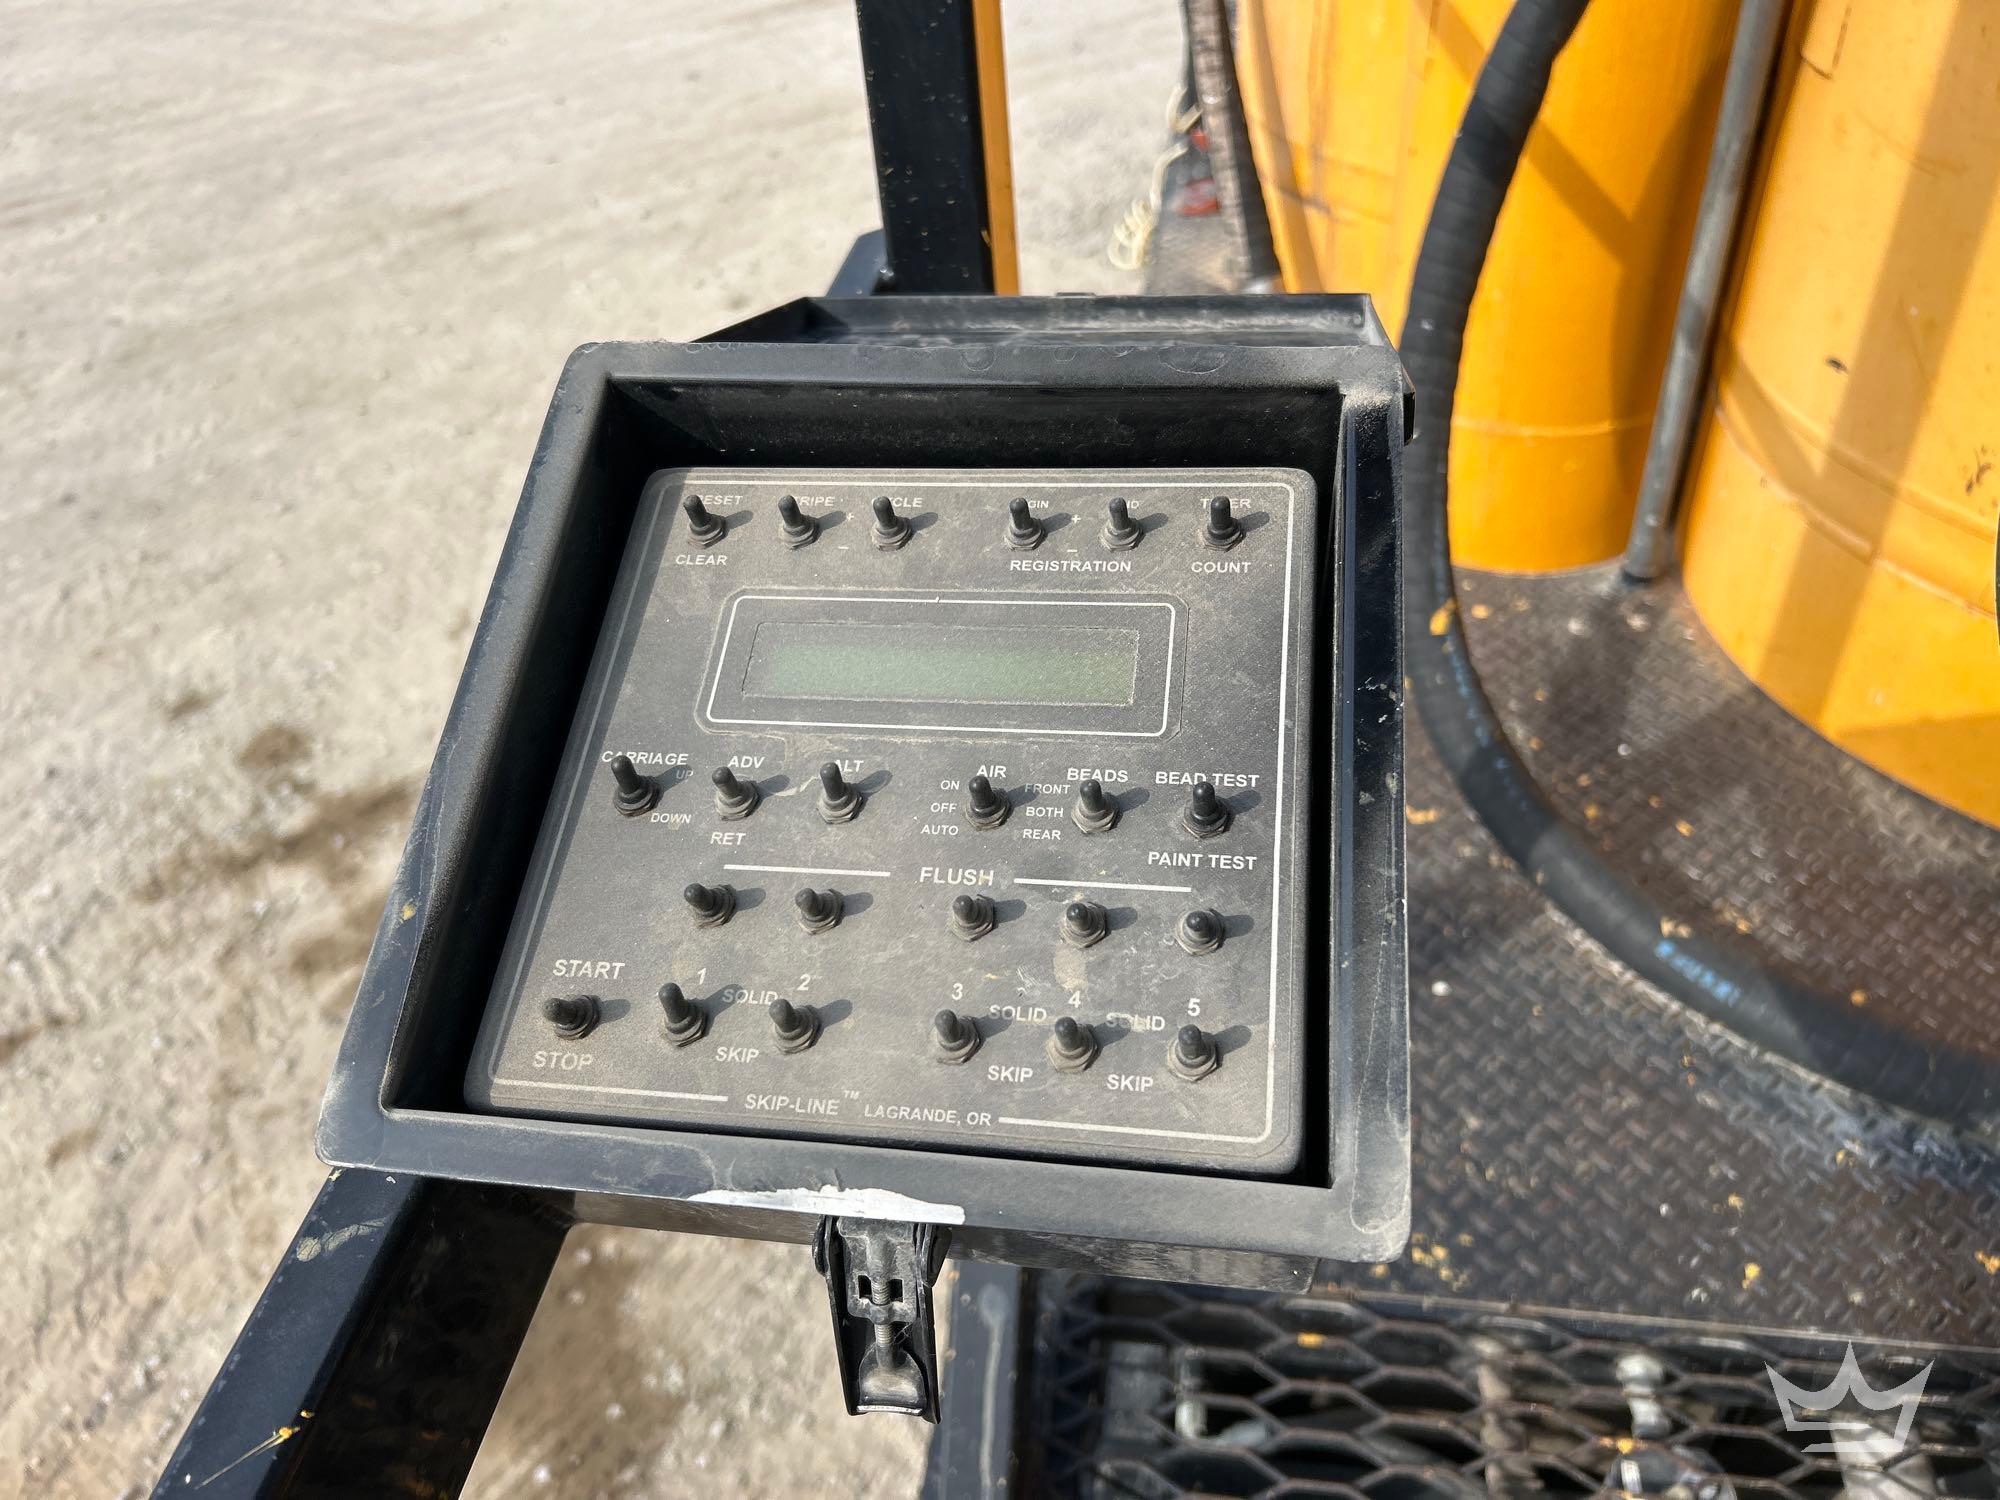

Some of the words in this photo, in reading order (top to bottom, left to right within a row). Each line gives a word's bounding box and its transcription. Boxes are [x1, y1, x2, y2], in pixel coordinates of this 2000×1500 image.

[871, 496, 924, 508] CLE
[675, 554, 728, 566] CLEAR
[1009, 560, 1132, 573] REGISTRATION
[1191, 561, 1252, 574] COUNT
[601, 750, 689, 766] CRRIAGE
[728, 755, 765, 769] ADV
[675, 768, 694, 780] UP
[976, 764, 1007, 778] AIR
[1067, 767, 1129, 783] BEADS
[940, 780, 960, 791] ON
[1155, 771, 1207, 785] BEAD
[1212, 773, 1260, 788] TEST
[1024, 783, 1071, 795] FRONT
[930, 802, 957, 814] OFF
[1025, 806, 1064, 819] BOTH
[651, 812, 692, 825] DOWN
[921, 824, 959, 837] AUTO
[1022, 828, 1062, 841] REAR
[710, 832, 746, 846] RET
[1148, 851, 1204, 868] PAINT
[1208, 854, 1257, 871] TEST
[919, 867, 995, 887] FLUSH
[552, 959, 625, 980] START
[697, 968, 707, 985] 1
[797, 973, 811, 991] 2
[722, 988, 779, 1006] SOLID
[951, 983, 963, 1001] 3
[1068, 991, 1081, 1009] 4
[989, 1004, 1048, 1022] SOLID
[1187, 997, 1201, 1017] 5
[532, 1051, 593, 1071] STOP
[715, 1046, 760, 1064] SKIP
[987, 1065, 1034, 1084] SKIP
[1106, 1073, 1154, 1093] SKIP
[744, 1093, 840, 1116] SKIP-LINE
[864, 1104, 961, 1127] LAGRANDE,
[966, 1112, 991, 1127] OR
